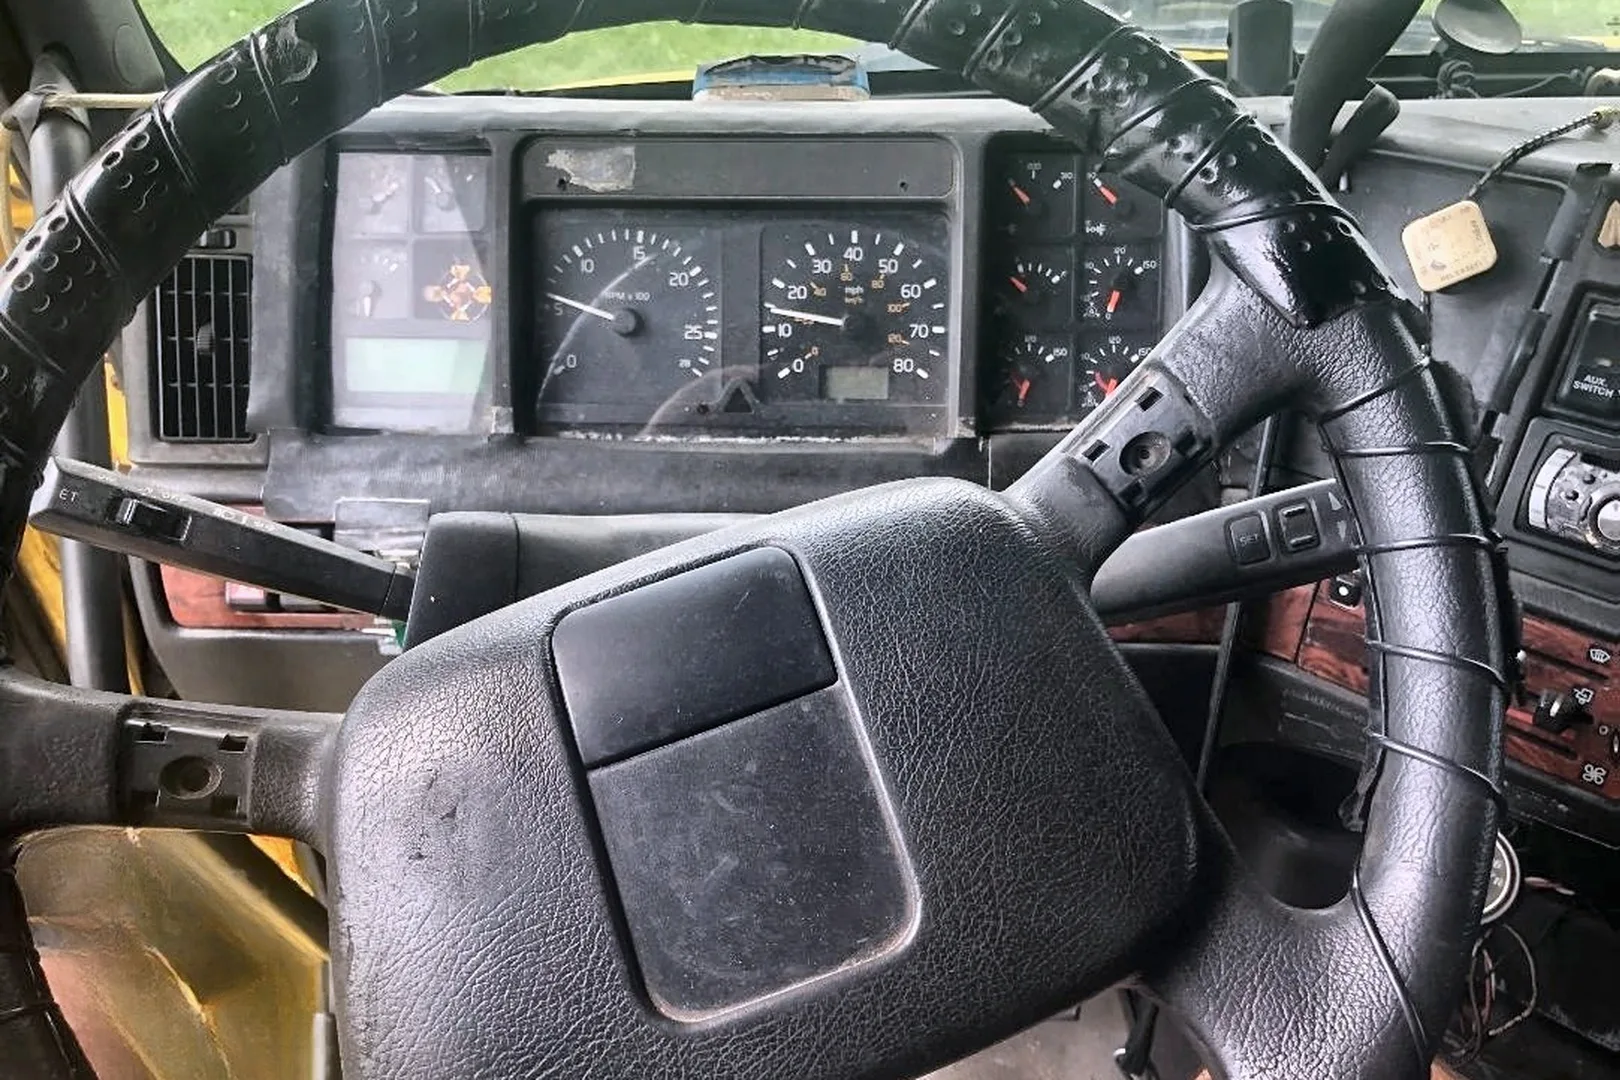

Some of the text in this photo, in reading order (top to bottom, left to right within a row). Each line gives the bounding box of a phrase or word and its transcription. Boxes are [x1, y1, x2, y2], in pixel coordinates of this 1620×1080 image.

[633, 246, 645, 260] 15
[843, 247, 863, 261] 40
[581, 259, 595, 273] 10
[812, 260, 832, 274] 30
[878, 259, 898, 274] 50
[1142, 260, 1157, 269] 150
[669, 272, 689, 287] 20
[787, 286, 807, 300] 20
[844, 286, 864, 295] mph
[900, 284, 921, 299] 60
[554, 304, 563, 316] 5
[684, 324, 703, 340] 25
[778, 323, 792, 338] 10
[910, 324, 929, 338] 70
[1053, 347, 1068, 356] 150
[567, 354, 577, 368] 0
[792, 358, 804, 373] 0
[893, 358, 914, 373] 80
[1584, 374, 1608, 387] AUX.
[1573, 380, 1614, 398] SWITCH
[1239, 533, 1258, 546] SET
